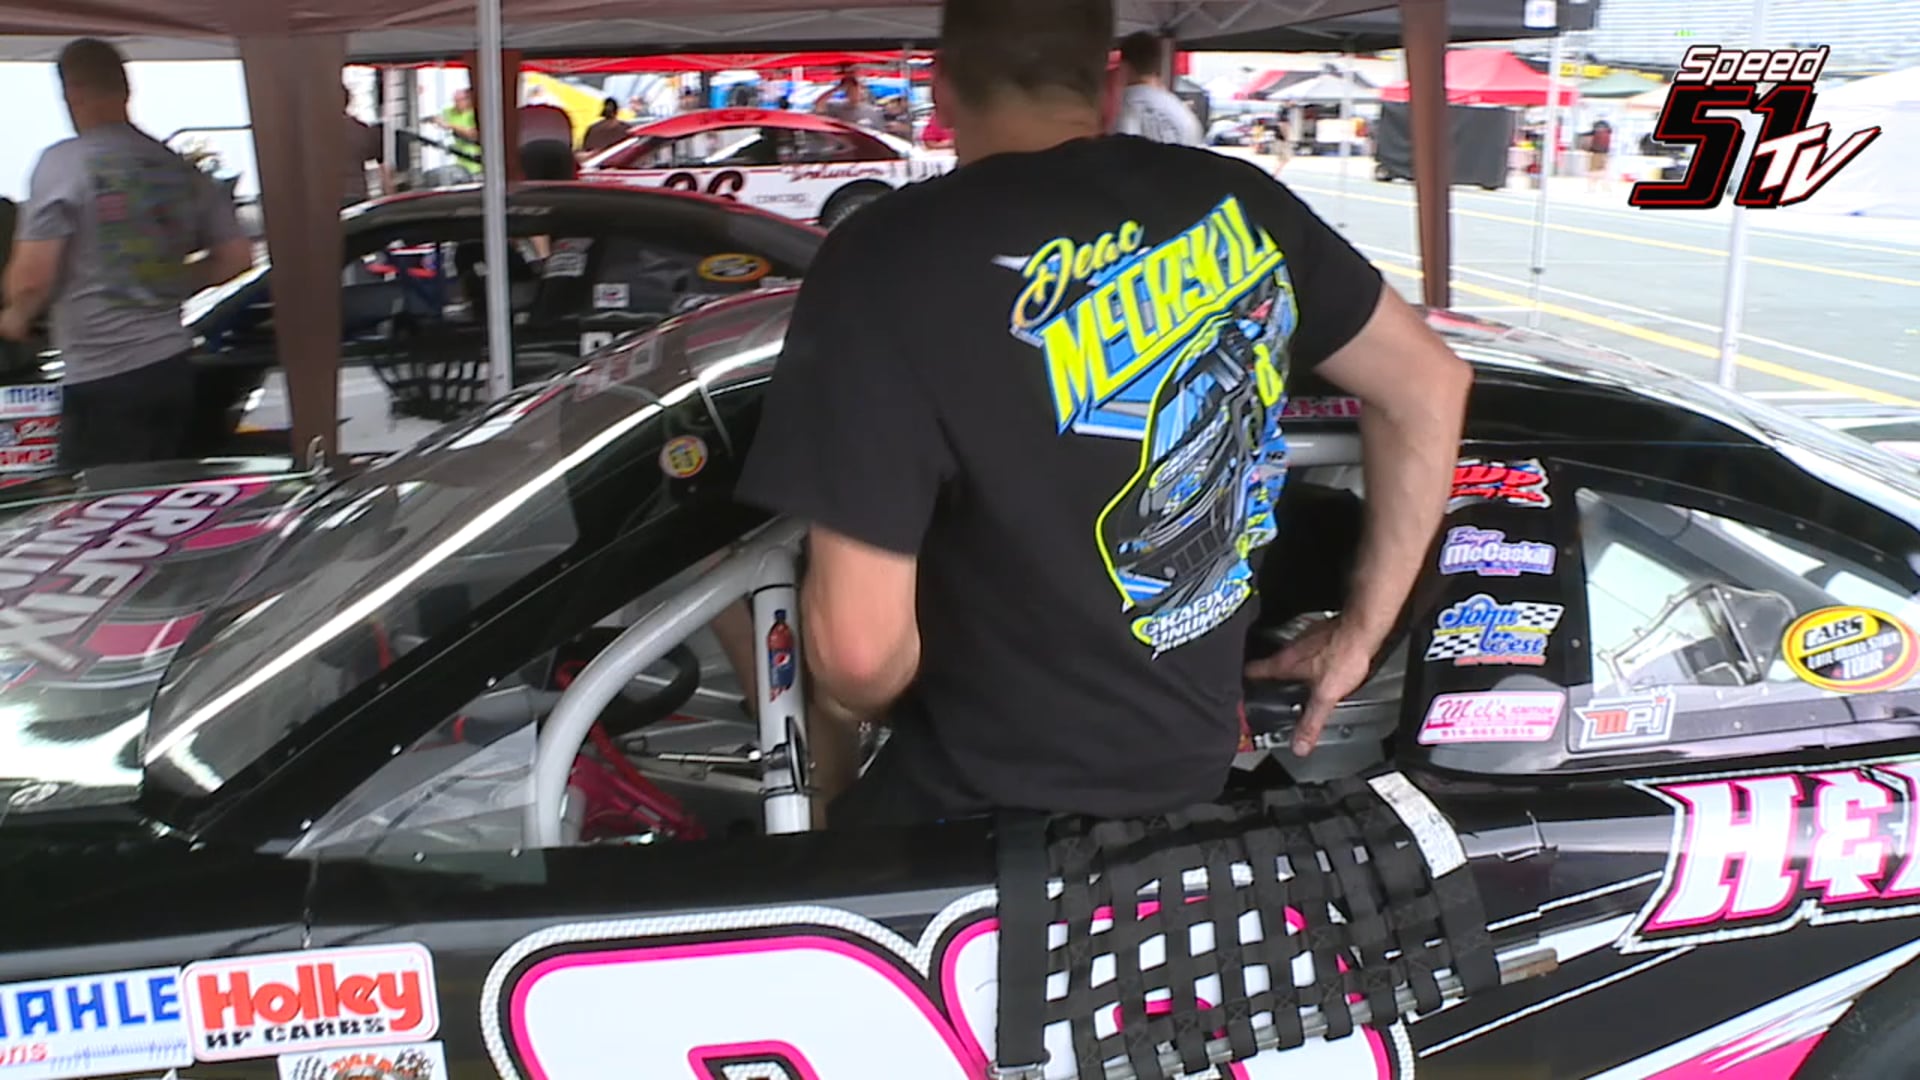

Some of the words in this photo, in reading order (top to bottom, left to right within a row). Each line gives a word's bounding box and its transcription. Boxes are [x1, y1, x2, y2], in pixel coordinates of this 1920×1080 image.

[0, 484, 242, 672] GRAFIX
[1842, 648, 1884, 680] TOUR
[0, 976, 181, 1038] AHLE
[197, 963, 424, 1032] Holley
[206, 1031, 252, 1049] HP
